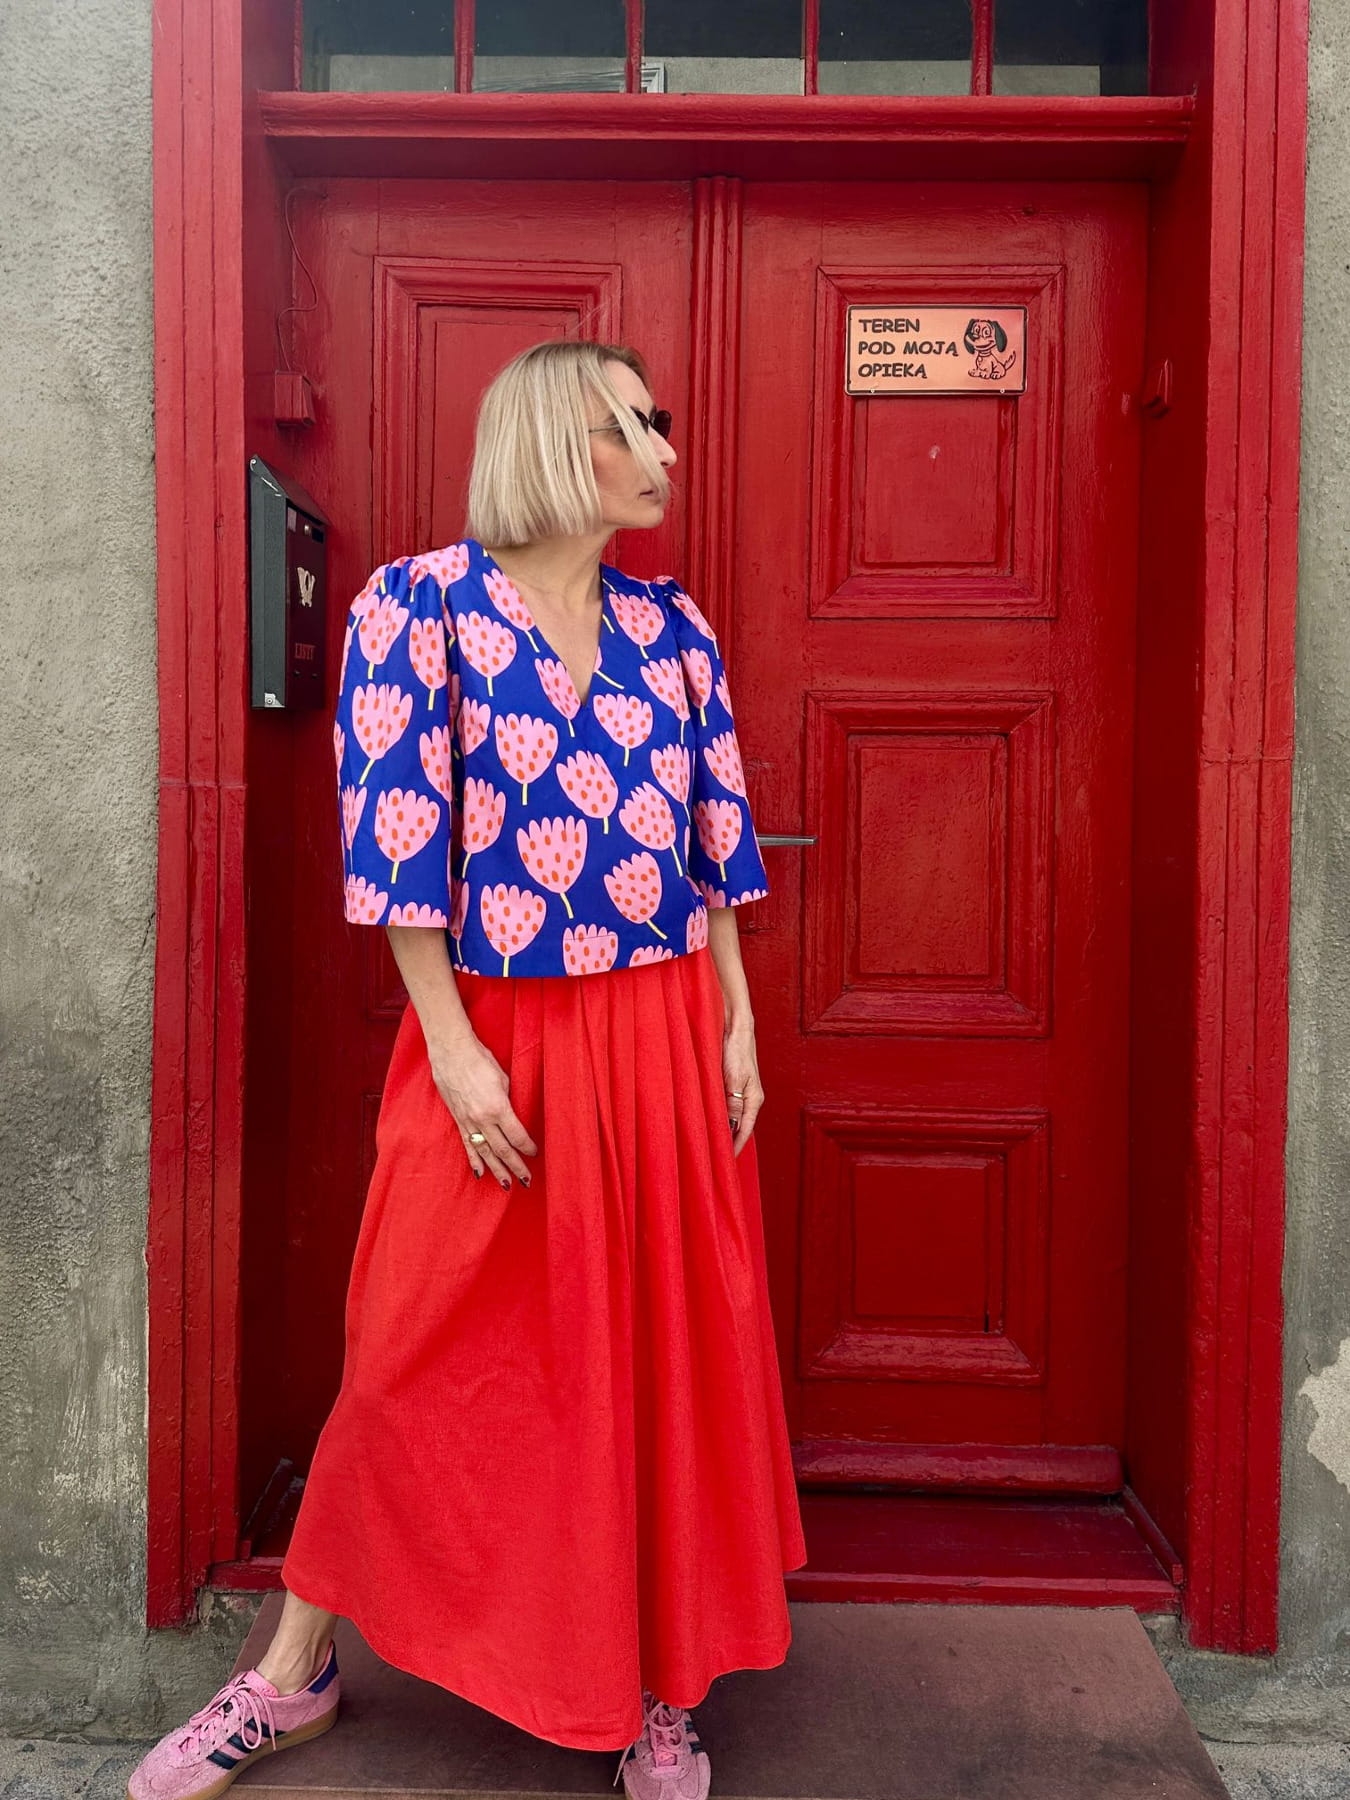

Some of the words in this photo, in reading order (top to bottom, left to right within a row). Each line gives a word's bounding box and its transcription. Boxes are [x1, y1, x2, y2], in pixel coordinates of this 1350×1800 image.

[858, 318, 920, 333] TEREN
[858, 341, 896, 355] POD
[903, 341, 959, 357] MOJĄ
[858, 363, 928, 379] OPIEKĄ
